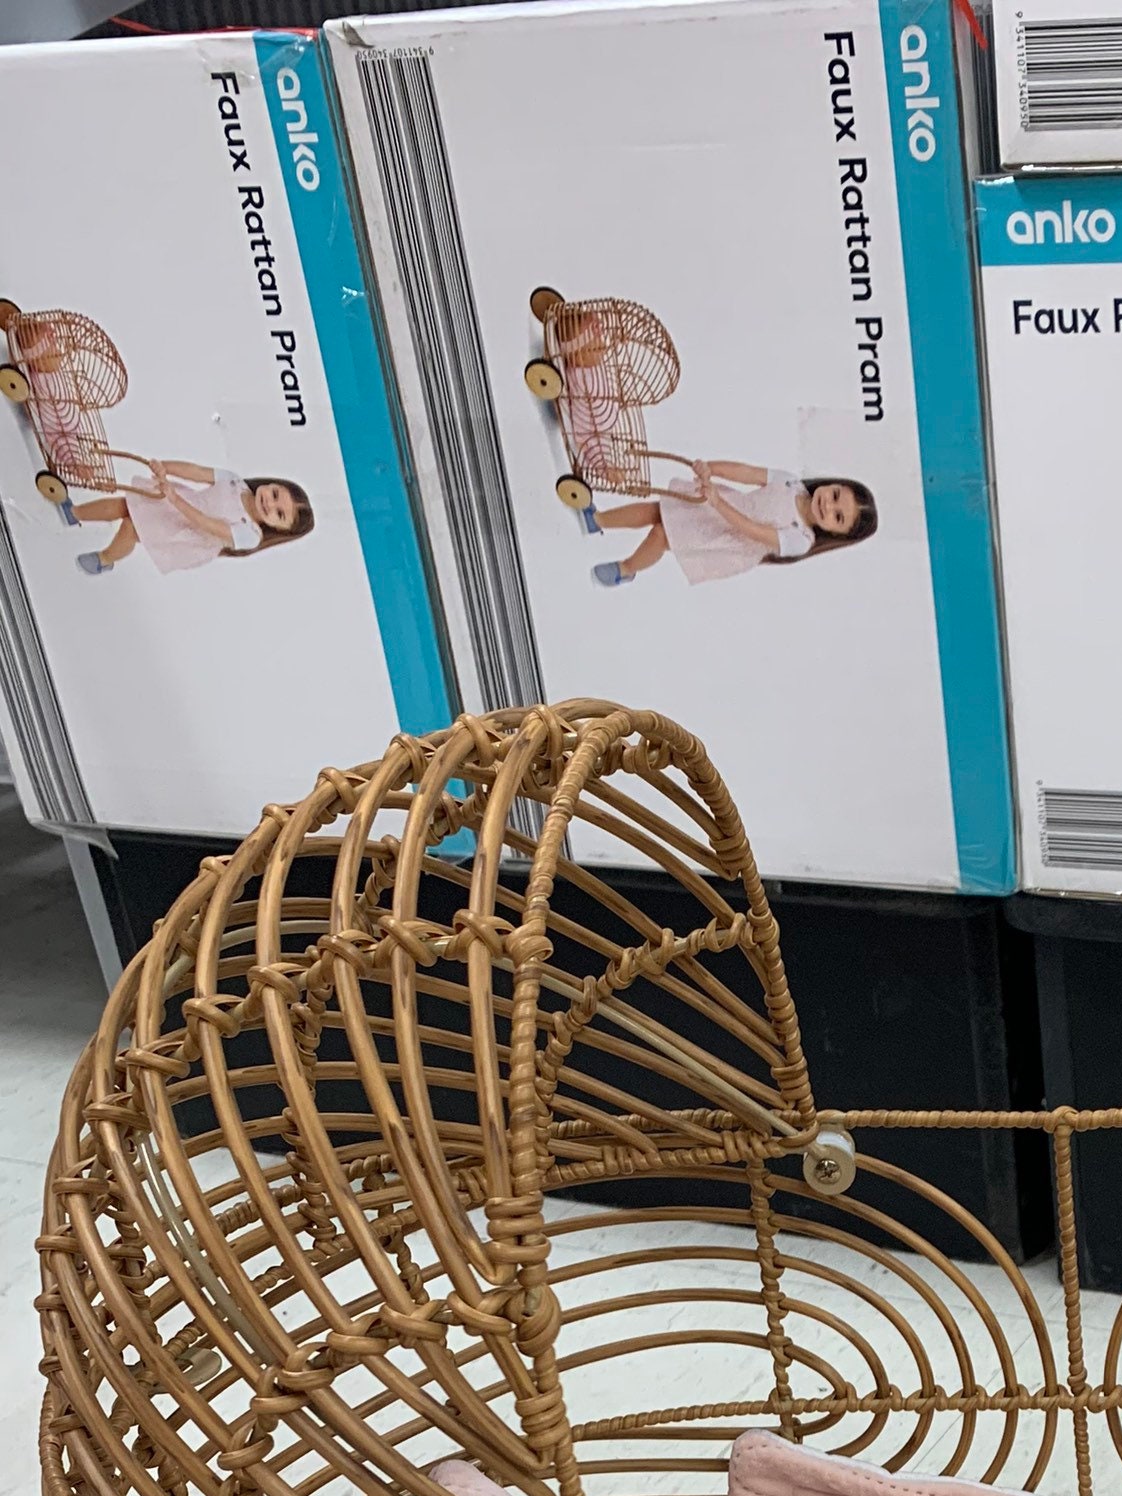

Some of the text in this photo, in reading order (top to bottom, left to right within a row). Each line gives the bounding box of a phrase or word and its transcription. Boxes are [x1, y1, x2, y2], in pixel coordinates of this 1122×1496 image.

[393, 46, 423, 58] 341107
[428, 45, 435, 56] 9
[900, 25, 940, 161] anko
[1015, 10, 1029, 128] 9 341107 340950
[276, 67, 319, 191] anko
[210, 71, 307, 427] Faux Rattan Pram
[823, 31, 884, 422] Faux Rattan Pram
[1006, 200, 1116, 244] anko
[1013, 299, 1101, 335] Faux
